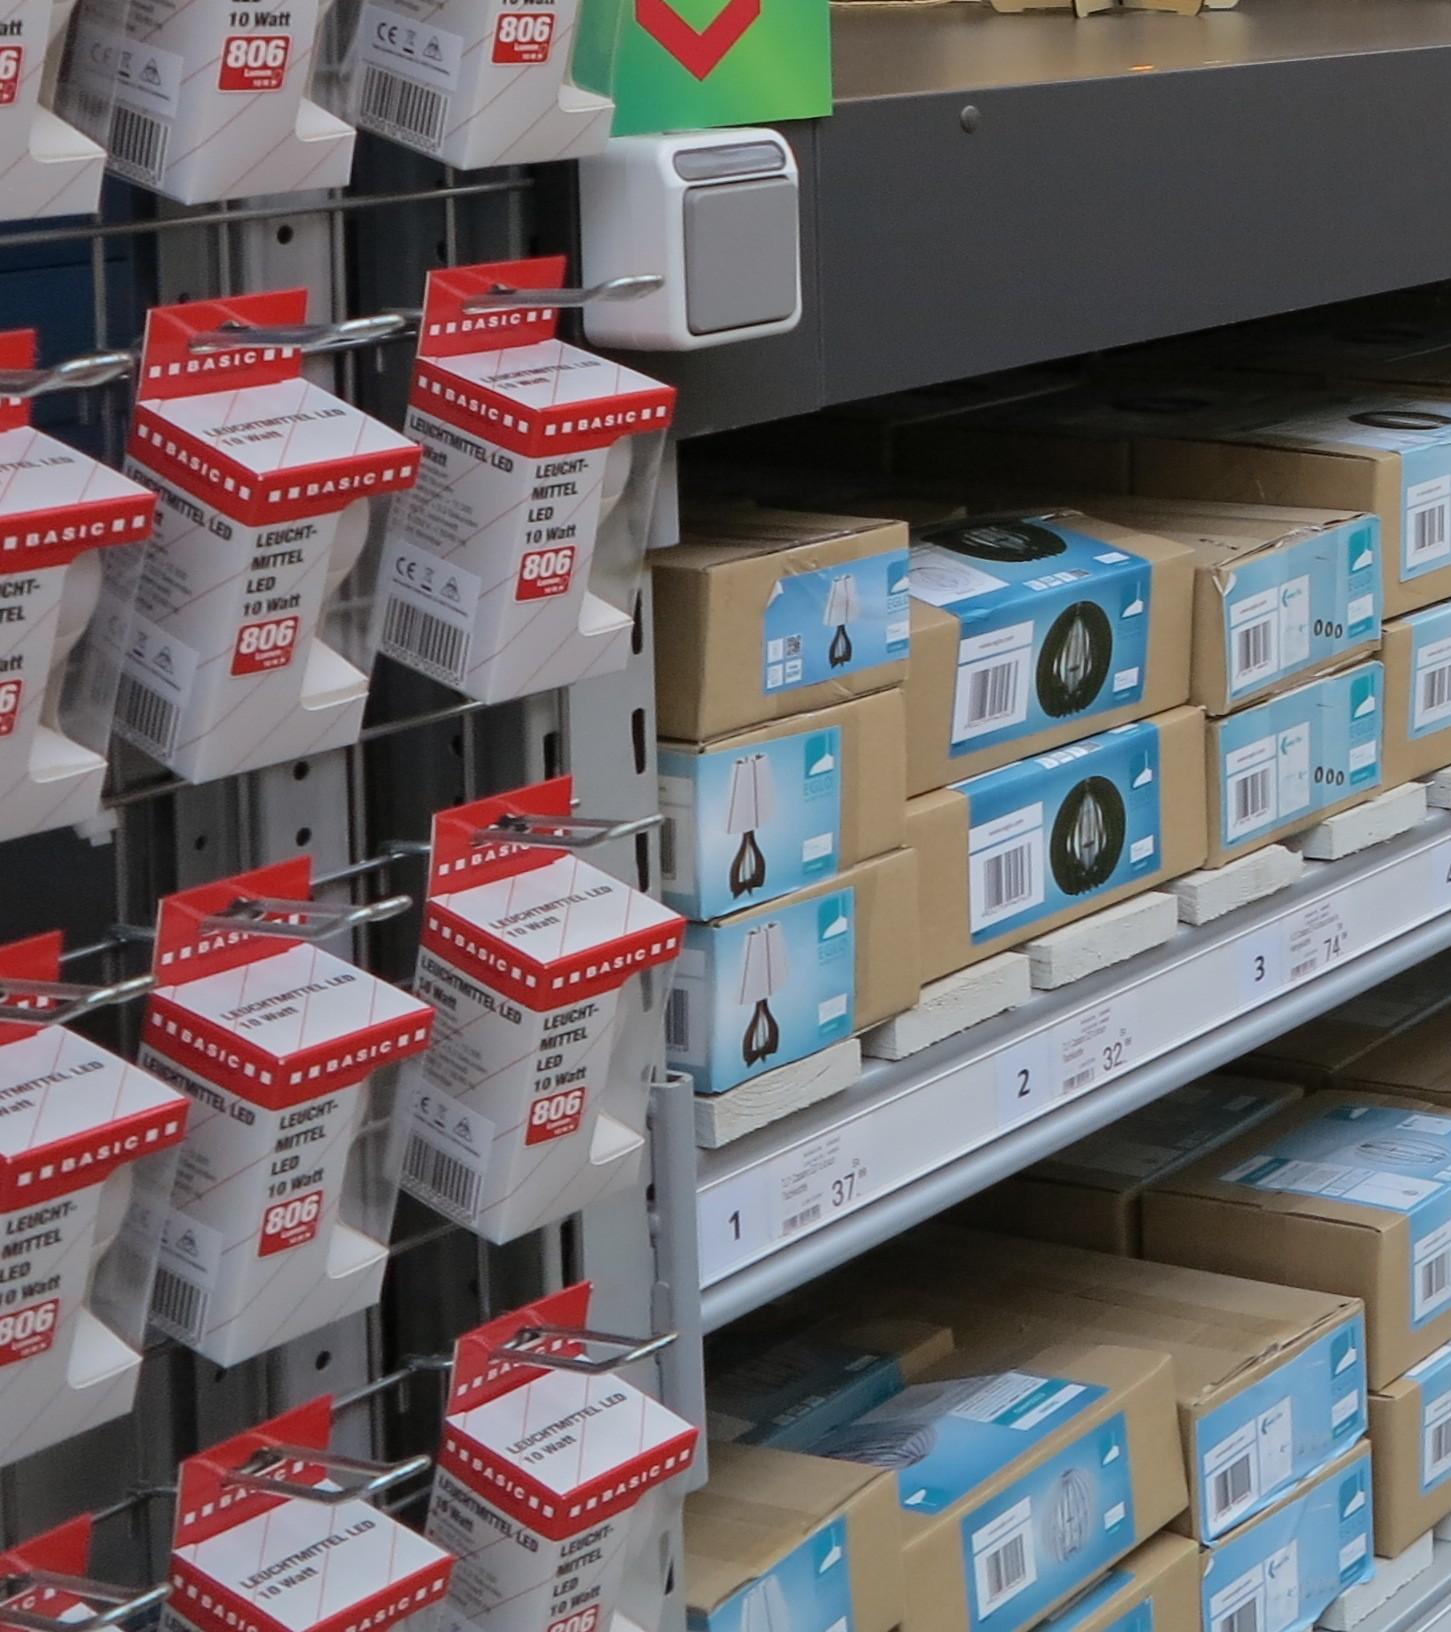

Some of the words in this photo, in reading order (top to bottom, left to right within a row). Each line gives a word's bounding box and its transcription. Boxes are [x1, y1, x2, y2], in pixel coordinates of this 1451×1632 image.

[229, 11, 250, 27] 10
[254, 11, 291, 28] Watt
[499, 15, 551, 43] 806
[225, 39, 286, 68] 806
[461, 313, 522, 332] BASIC
[186, 351, 257, 373] BASIC
[445, 388, 498, 420] BASIC
[203, 413, 315, 438] LEUCHTMITTEL
[317, 407, 348, 420] LED
[578, 411, 636, 431] BASIC
[246, 430, 283, 443] Watt
[410, 414, 488, 463] LEUCHTMITTEL
[491, 452, 514, 475] LED
[166, 441, 220, 483] BASIC
[535, 458, 589, 480] LEUCHT-
[306, 472, 376, 496] BASIC
[531, 481, 578, 501] MITTEL
[209, 516, 233, 541] LED
[528, 506, 554, 523] LED
[26, 522, 105, 547] BASIC
[256, 524, 318, 548] LEUCHT-
[525, 528, 543, 544] 10
[546, 524, 576, 541] Watt
[251, 549, 304, 572] MITTEL
[522, 549, 572, 580] 806
[246, 576, 276, 594] LED
[243, 600, 262, 616] 10
[266, 594, 300, 613] Watt
[239, 620, 295, 654] 806
[489, 894, 587, 930] LEUCHTMITTEL
[585, 885, 613, 900] LED
[528, 916, 561, 931] Watt
[454, 933, 508, 973] BASIC
[585, 948, 646, 977] BASIC
[1254, 955, 1265, 981] 3
[219, 983, 328, 1021] LEUCHTMITTEL
[326, 973, 356, 987] LED
[543, 1003, 599, 1031] LEUCHT-
[181, 1030, 240, 1069] BASIC
[325, 1041, 393, 1073] BASIC
[1017, 1068, 1030, 1098] 2
[531, 1089, 581, 1126] 806
[61, 1135, 139, 1172] BASIC
[5, 1200, 77, 1235] LEUCHT-
[265, 1194, 320, 1235] 806
[728, 1209, 741, 1241] 1
[506, 1403, 602, 1455] LEUCHTMITTEL
[600, 1391, 627, 1409] LED
[523, 1449, 543, 1465] 10
[543, 1434, 577, 1456] Watt
[472, 1458, 525, 1500] BASIC
[601, 1464, 661, 1503] BASIC
[239, 1533, 349, 1590] LEUCHTMITTEL
[346, 1519, 376, 1538] LED
[257, 1585, 282, 1600] 10
[281, 1566, 319, 1591] Watt
